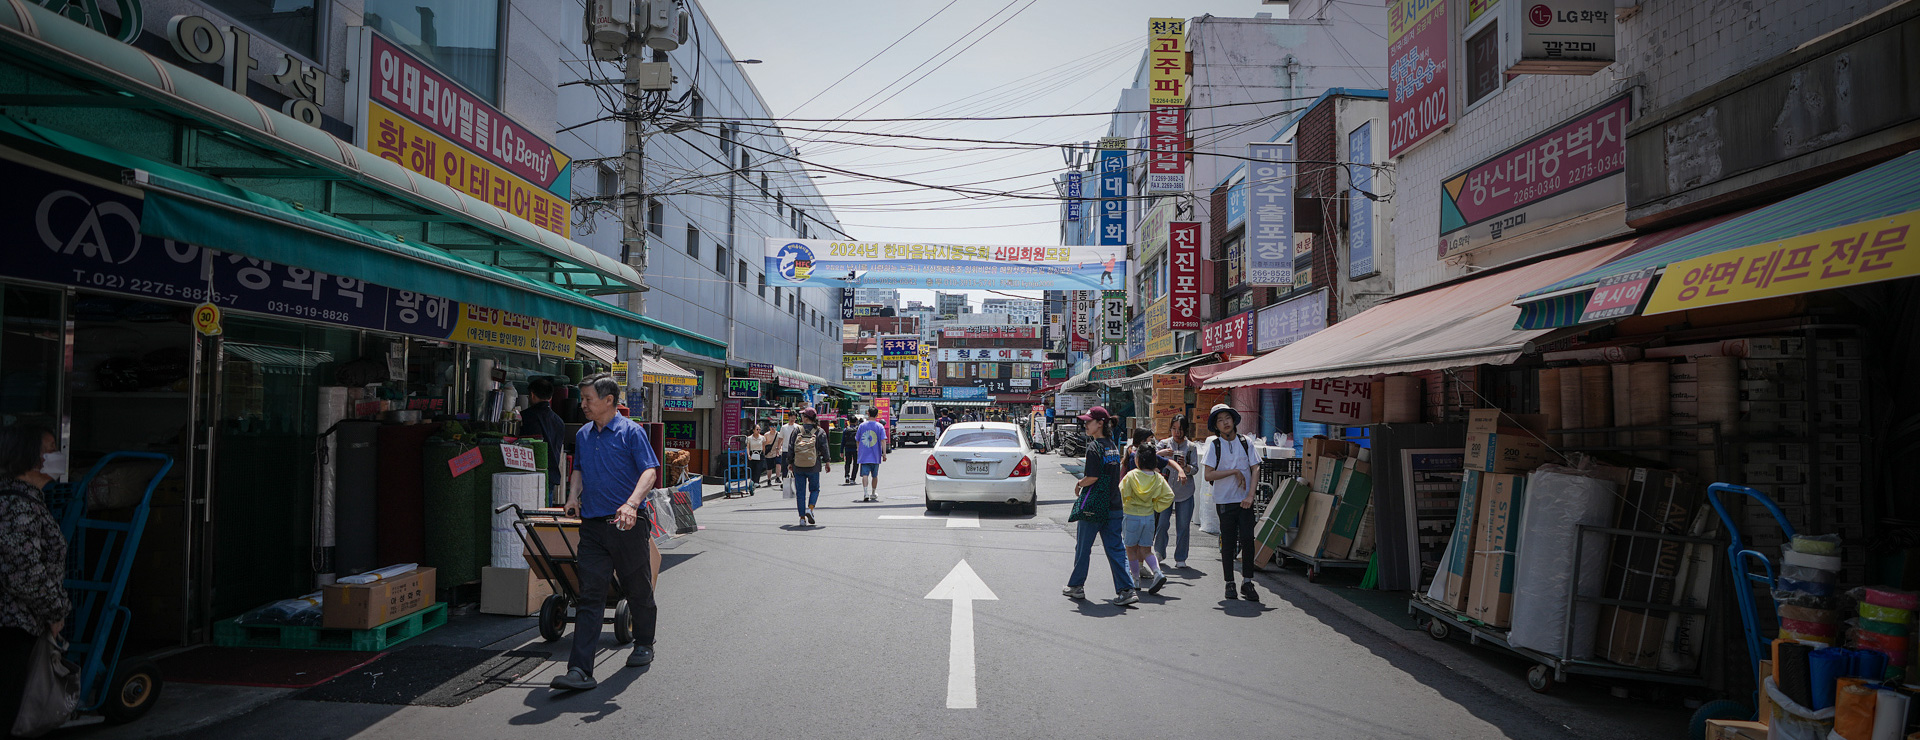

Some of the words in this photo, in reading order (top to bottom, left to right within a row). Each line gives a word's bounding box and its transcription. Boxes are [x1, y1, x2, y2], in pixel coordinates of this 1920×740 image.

[1152, 21, 1183, 35] 천진
[1557, 10, 1608, 24] LG화학
[1543, 41, 1596, 57] 깔끄미
[167, 15, 326, 129] 아성
[1154, 38, 1182, 97] 고주파
[380, 50, 489, 152] 인테리어필름
[492, 117, 513, 165] LG
[515, 141, 552, 182] Benif
[1391, 86, 1446, 152] 2278.1002
[1469, 107, 1626, 207] 방산대흥벽지
[377, 118, 435, 182] 황해
[443, 151, 566, 235] 인테리어필름
[1513, 175, 1560, 205] 2265-0340
[1568, 150, 1625, 184] 2275-0340
[1256, 148, 1288, 260] 대양수출포장
[1489, 212, 1526, 241] 깔끄미
[830, 242, 879, 259] 2024년
[883, 243, 990, 261] 한마음낚시동우회
[994, 246, 1071, 262] 신입회원모집
[1449, 234, 1471, 251] LG화학
[795, 260, 811, 268] HFC
[1175, 229, 1198, 317] 진진포장
[1677, 256, 1743, 302] 양면
[1741, 244, 1820, 290] 테프
[1820, 224, 1912, 280] 전문
[72, 269, 126, 289] T.02)
[199, 311, 212, 323] 30
[267, 300, 349, 322] 031-919-8826
[1107, 302, 1123, 336] 간판
[1260, 301, 1323, 339] 대양수출포장
[1172, 321, 1199, 329] 2279-9590
[1204, 317, 1245, 347] 진진포장
[885, 341, 917, 351] 주차장
[667, 385, 692, 395] 주차장
[731, 380, 759, 392] 주차장
[1310, 378, 1371, 400] 바닥재
[665, 400, 693, 408] 시간주차장
[1312, 398, 1361, 419] 도매
[1504, 448, 1520, 456] 200
[1462, 493, 1475, 543] STYLE
[1493, 501, 1508, 556] STYLE
[1657, 502, 1688, 578] AVNUE
[390, 590, 422, 606] 아성화학
